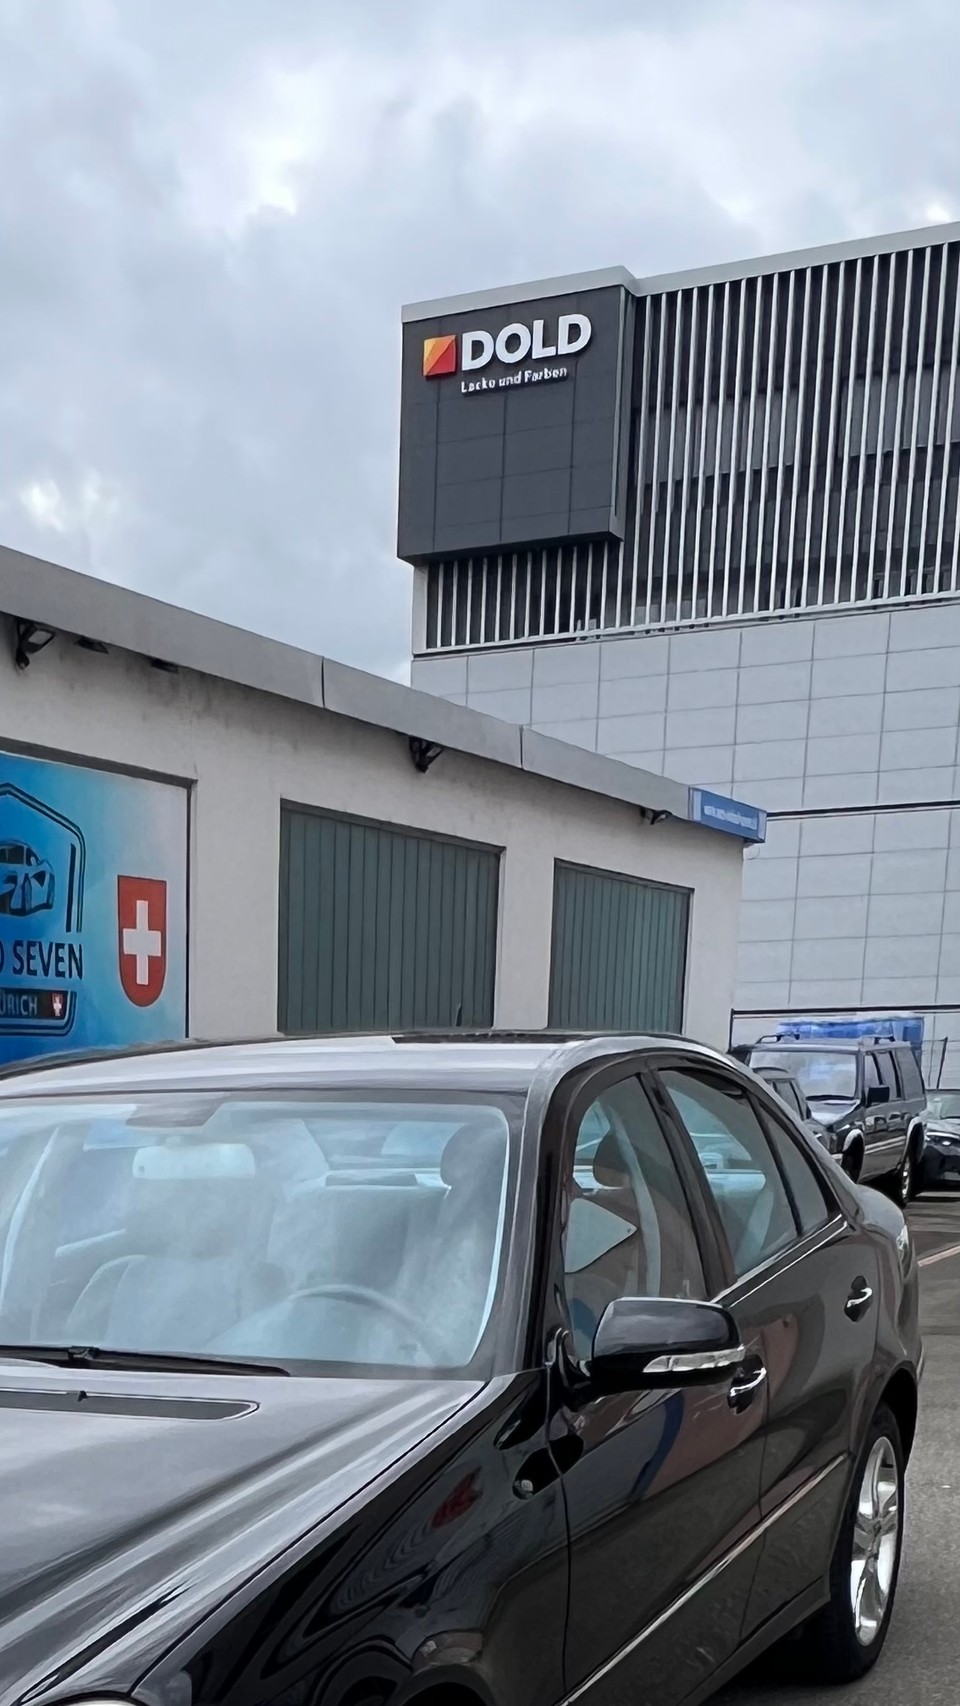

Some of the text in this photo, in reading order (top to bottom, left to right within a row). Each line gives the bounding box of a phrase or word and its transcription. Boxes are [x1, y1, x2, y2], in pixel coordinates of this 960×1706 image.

[461, 314, 592, 371] DOLD
[461, 367, 567, 393] Lacke und Farben
[12, 940, 83, 980] SEVEN
